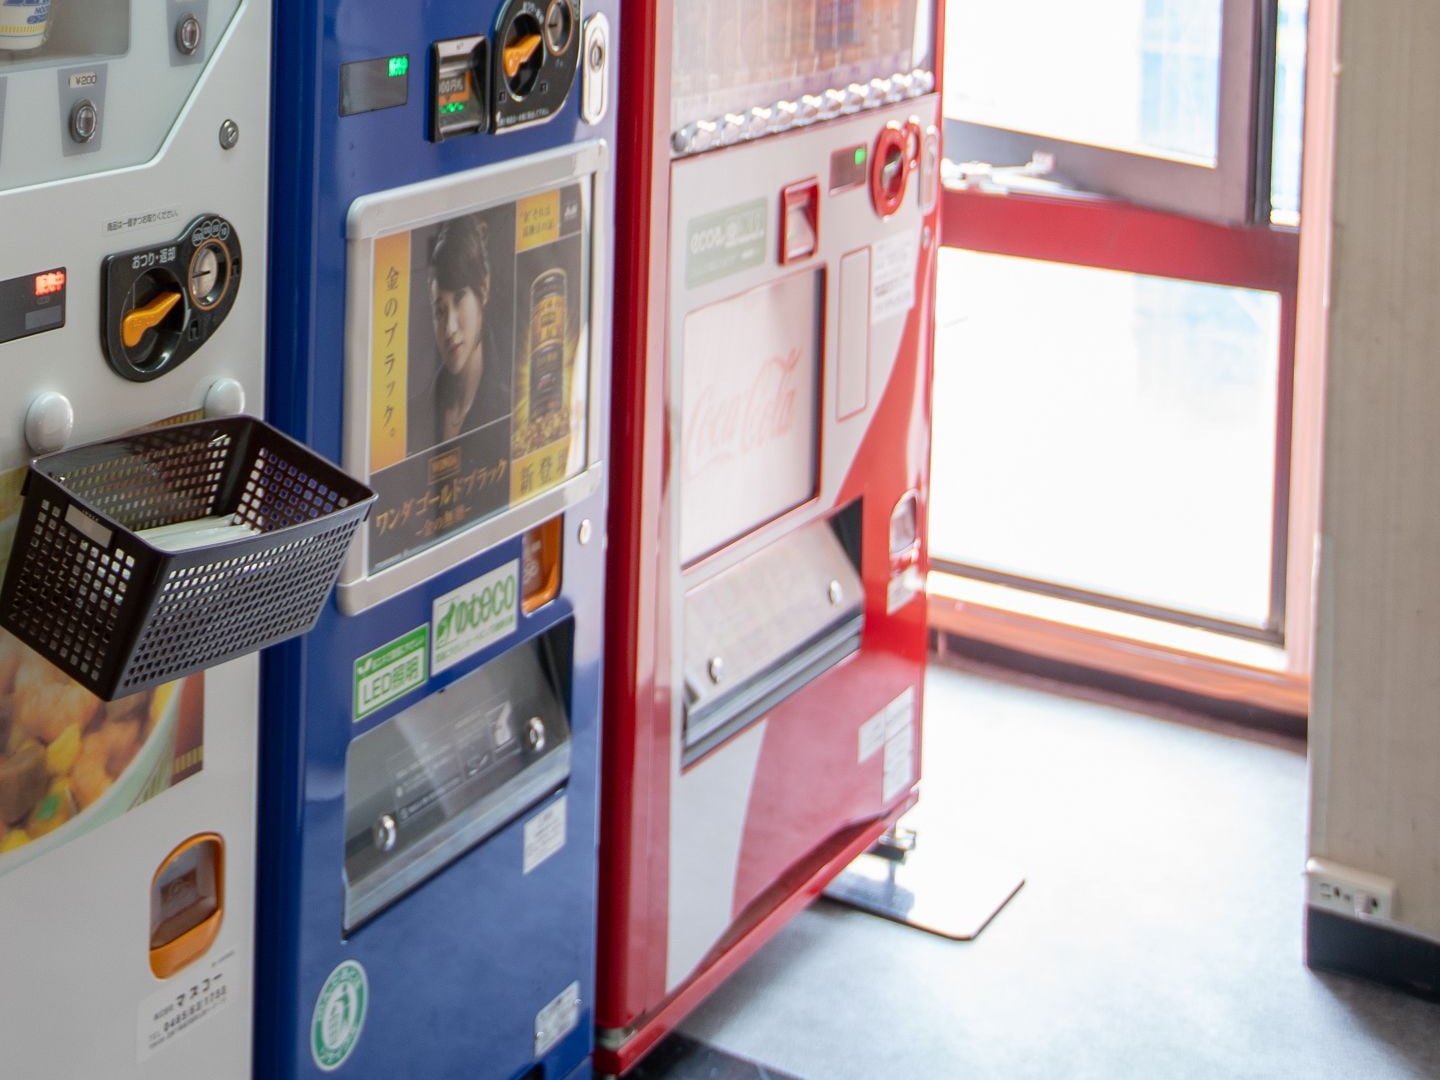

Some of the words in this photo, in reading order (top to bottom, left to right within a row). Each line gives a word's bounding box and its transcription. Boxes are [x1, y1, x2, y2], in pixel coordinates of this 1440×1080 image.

[75, 75, 97, 86] ¥200
[132, 246, 176, 269] おつり・返却
[383, 265, 399, 438] 金のブラック。
